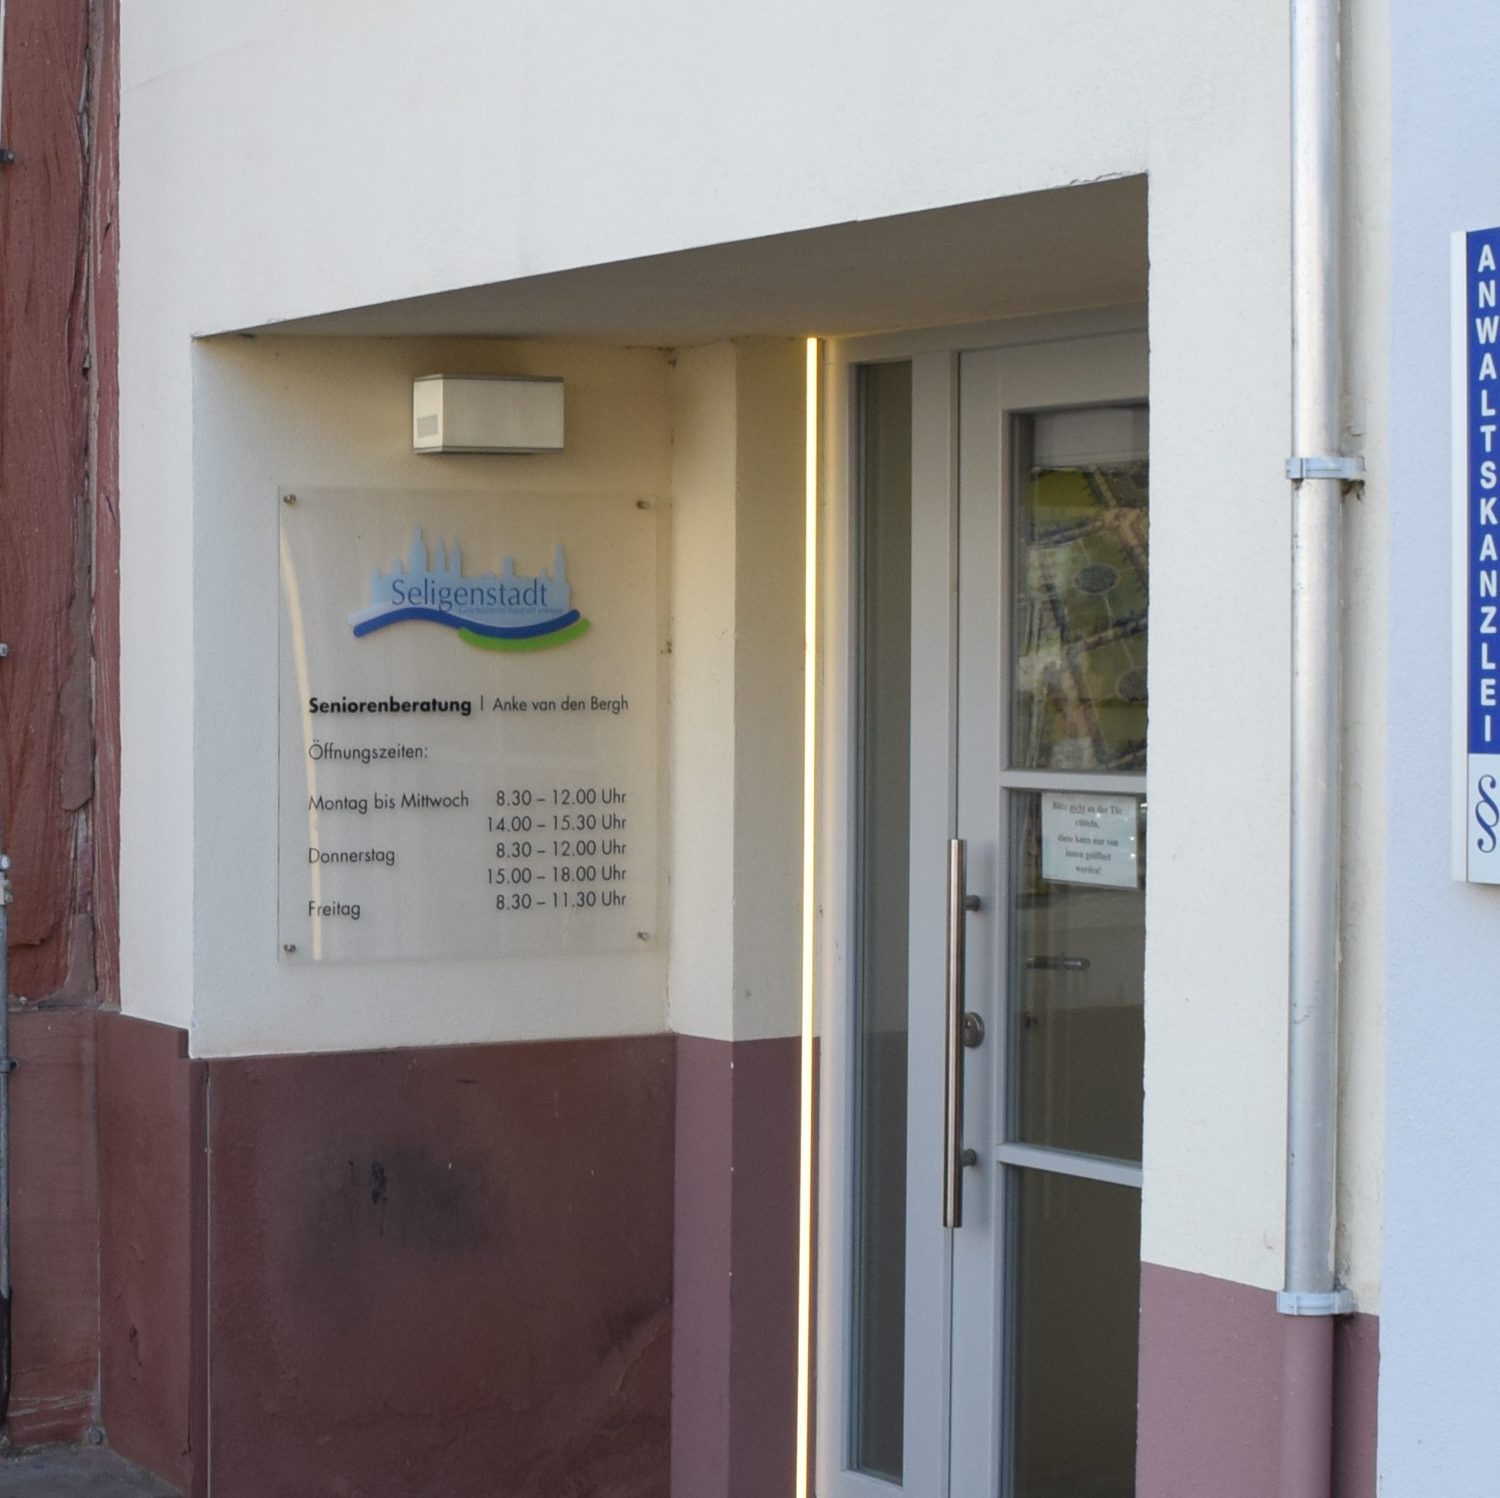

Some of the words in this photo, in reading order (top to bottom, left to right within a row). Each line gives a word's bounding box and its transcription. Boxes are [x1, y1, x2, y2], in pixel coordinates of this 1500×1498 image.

[1475, 244, 1500, 743] ANWALTSKANZLEI
[390, 577, 549, 612] Seligenstadt
[308, 695, 472, 718] Seniorenberatung
[492, 695, 528, 712] Anke
[531, 700, 557, 712] van
[561, 695, 586, 712] den
[590, 694, 629, 715] Bergh
[308, 739, 428, 765] Öffnungszeiten:
[308, 795, 368, 815] Montag
[374, 792, 396, 810] bis
[400, 789, 469, 809] Mittwoch
[496, 789, 532, 807] 8.30
[553, 788, 597, 806] 12.00
[601, 787, 627, 805] Uhr
[487, 815, 532, 832] 14.00
[553, 814, 597, 831] 15.30
[601, 812, 627, 830] Uhr
[308, 847, 396, 867] Donnerstag
[496, 841, 532, 859] 8.30
[553, 839, 597, 857] 12.00
[601, 838, 627, 856] Uhr
[487, 867, 532, 885] 15.00
[553, 865, 597, 883] 18.00
[601, 863, 627, 881] Uhr
[308, 900, 361, 921] Freitag
[495, 893, 532, 911] 8.30
[553, 890, 597, 908] 11.30
[601, 889, 627, 907] Uhr
